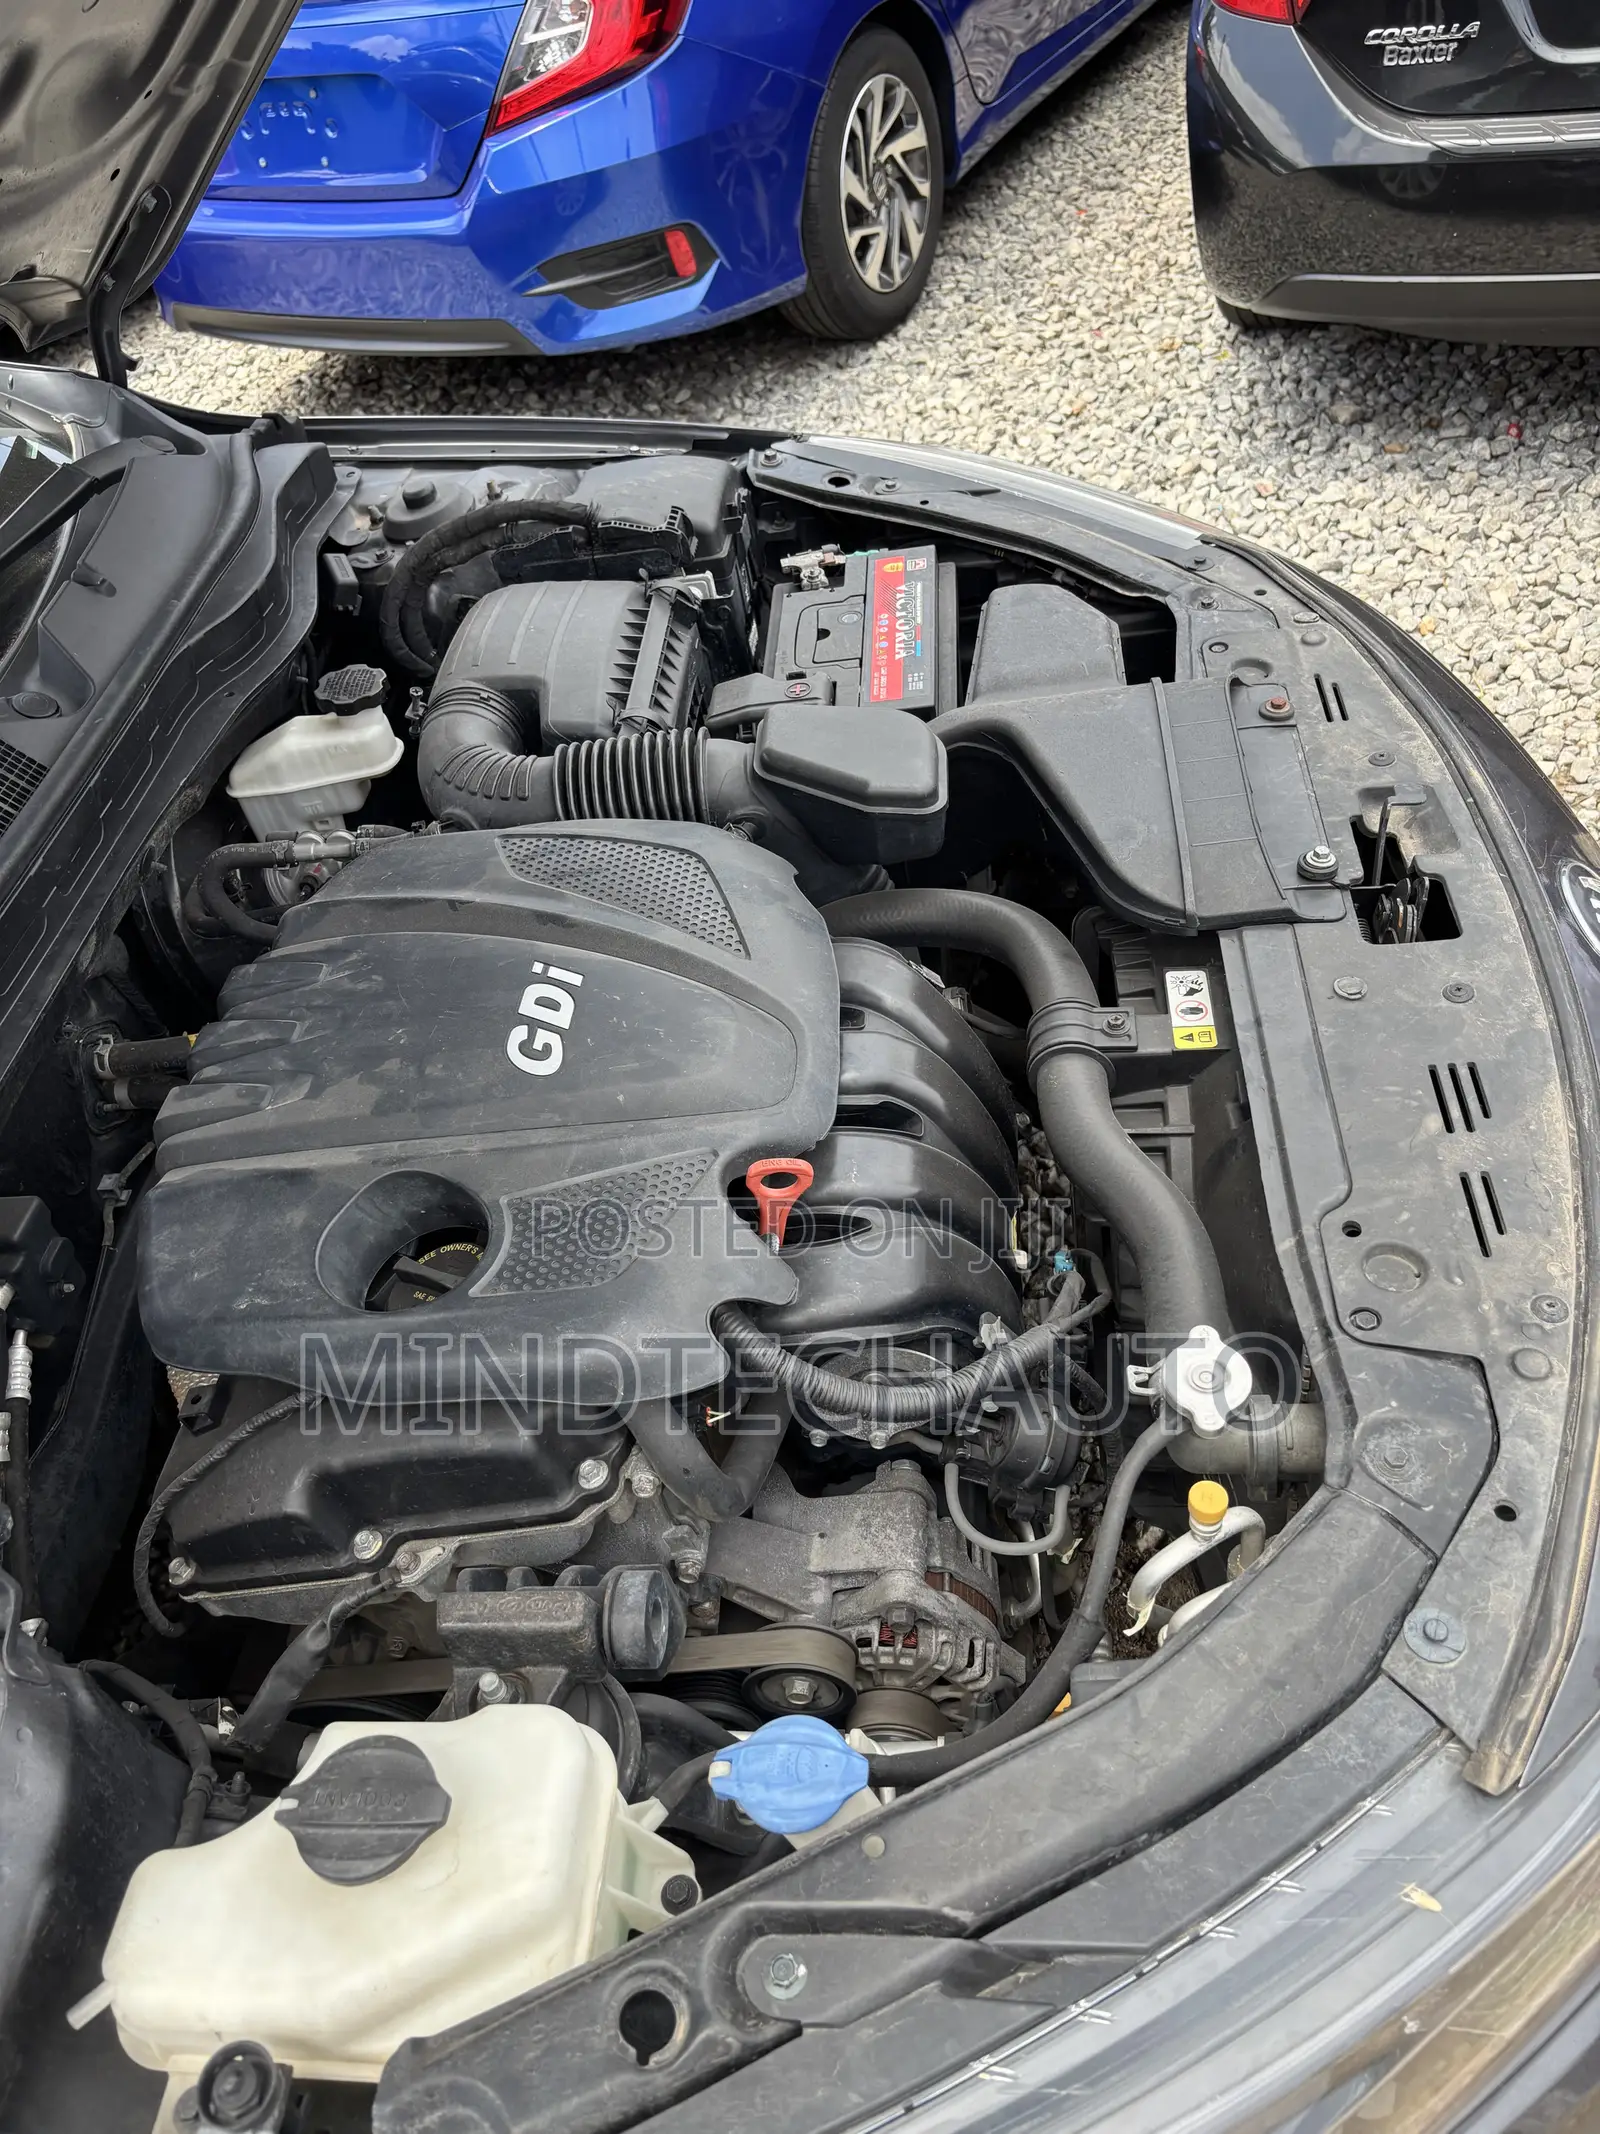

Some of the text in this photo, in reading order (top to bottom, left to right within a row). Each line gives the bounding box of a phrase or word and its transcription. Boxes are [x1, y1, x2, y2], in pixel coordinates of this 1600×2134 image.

[1364, 21, 1480, 45] COROLLA
[1383, 42, 1458, 66] Baxter
[895, 581, 916, 661] VICTORIA
[506, 961, 585, 1076] GDi
[418, 1243, 479, 1265] SEE OWNER'S
[413, 1291, 427, 1300] SAE
[313, 1787, 408, 1811] COOLANT
